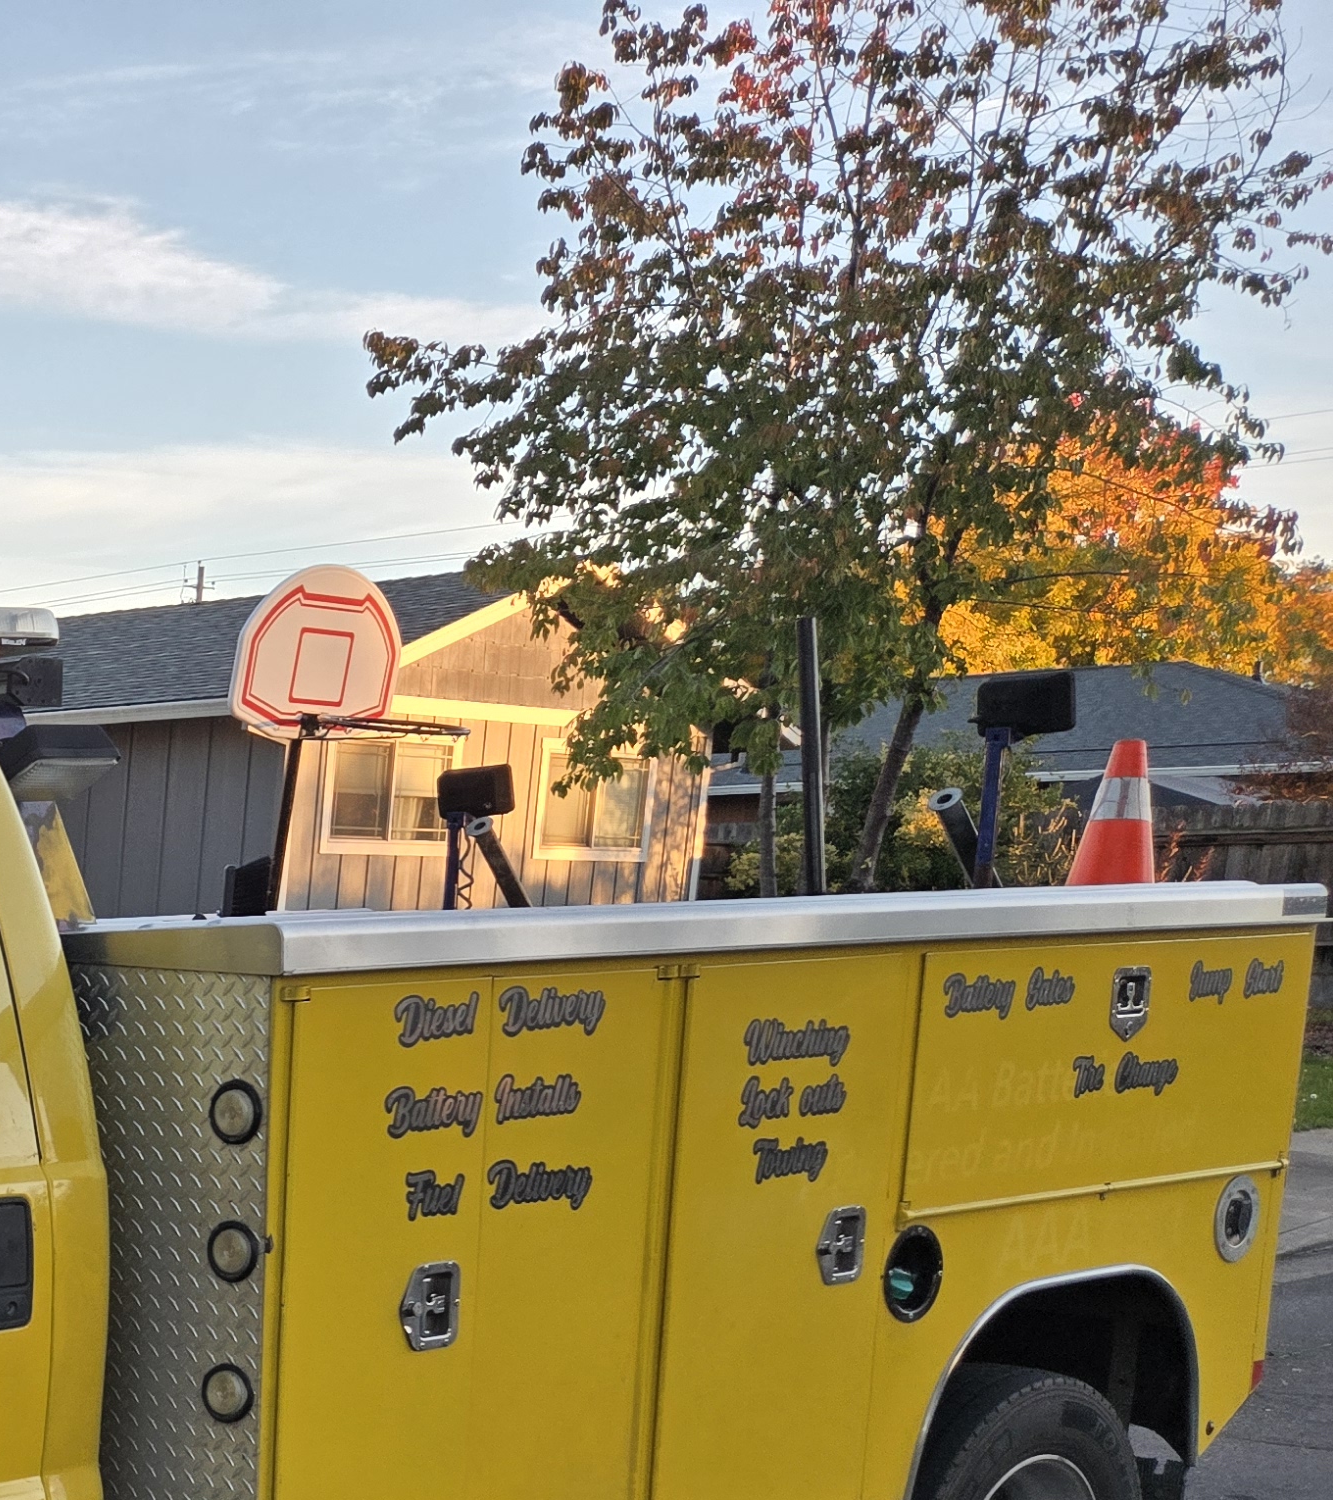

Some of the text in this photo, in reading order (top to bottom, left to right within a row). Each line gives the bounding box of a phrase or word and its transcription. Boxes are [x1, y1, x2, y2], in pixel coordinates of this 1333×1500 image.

[944, 966, 1076, 1020] Battery Sales
[1189, 958, 1284, 1005] Jump Start
[394, 986, 606, 1048] Diesel Delivery
[743, 1018, 851, 1067] Winching
[738, 1073, 847, 1129] Lock outs
[1073, 1051, 1179, 1098] Tire Change
[385, 1074, 582, 1138] Battery Installs
[753, 1136, 828, 1185] Towing
[406, 1159, 593, 1221] Fuel Delivery
